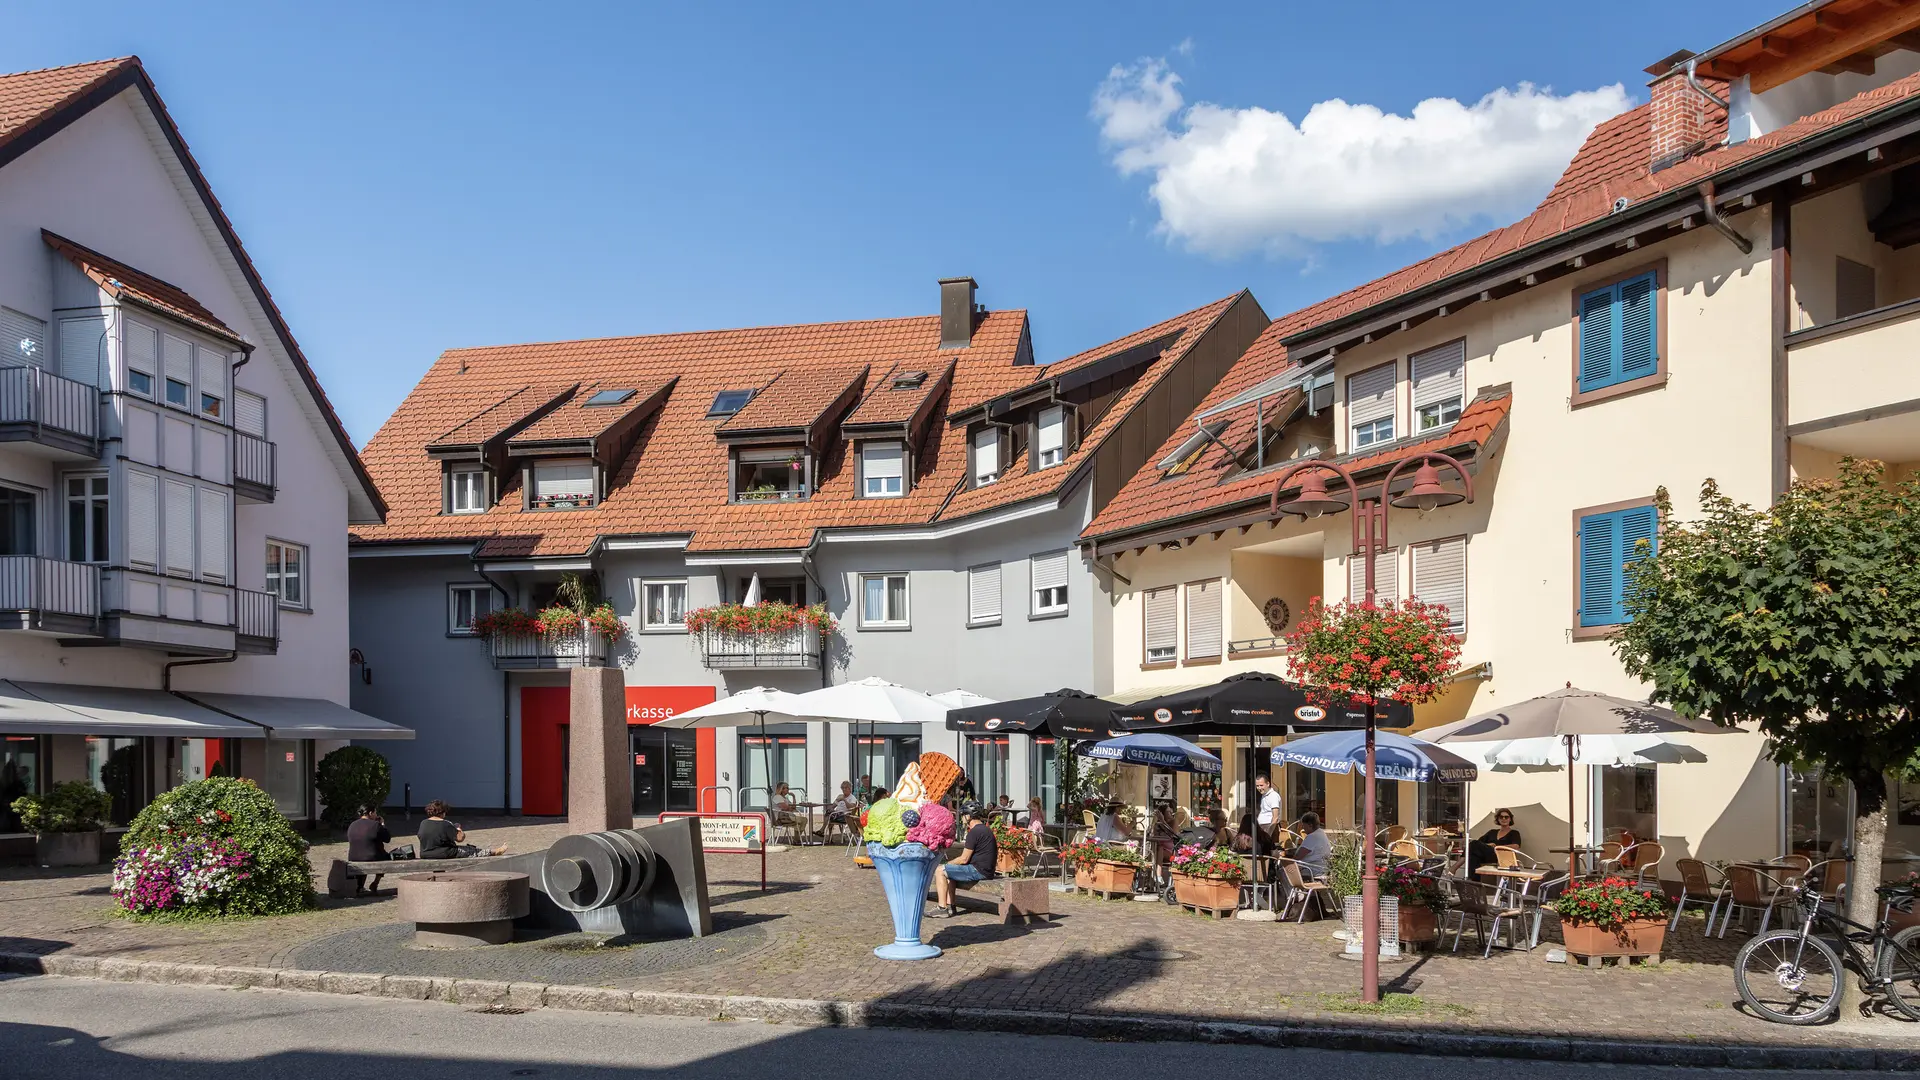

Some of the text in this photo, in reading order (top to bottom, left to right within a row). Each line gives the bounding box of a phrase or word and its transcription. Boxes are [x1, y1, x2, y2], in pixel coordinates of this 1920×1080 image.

[627, 703, 674, 718] rkasse
[1300, 709, 1320, 718] bristot
[1131, 750, 1182, 763] GETRÄNKE
[1286, 752, 1348, 770] SCHINDLER
